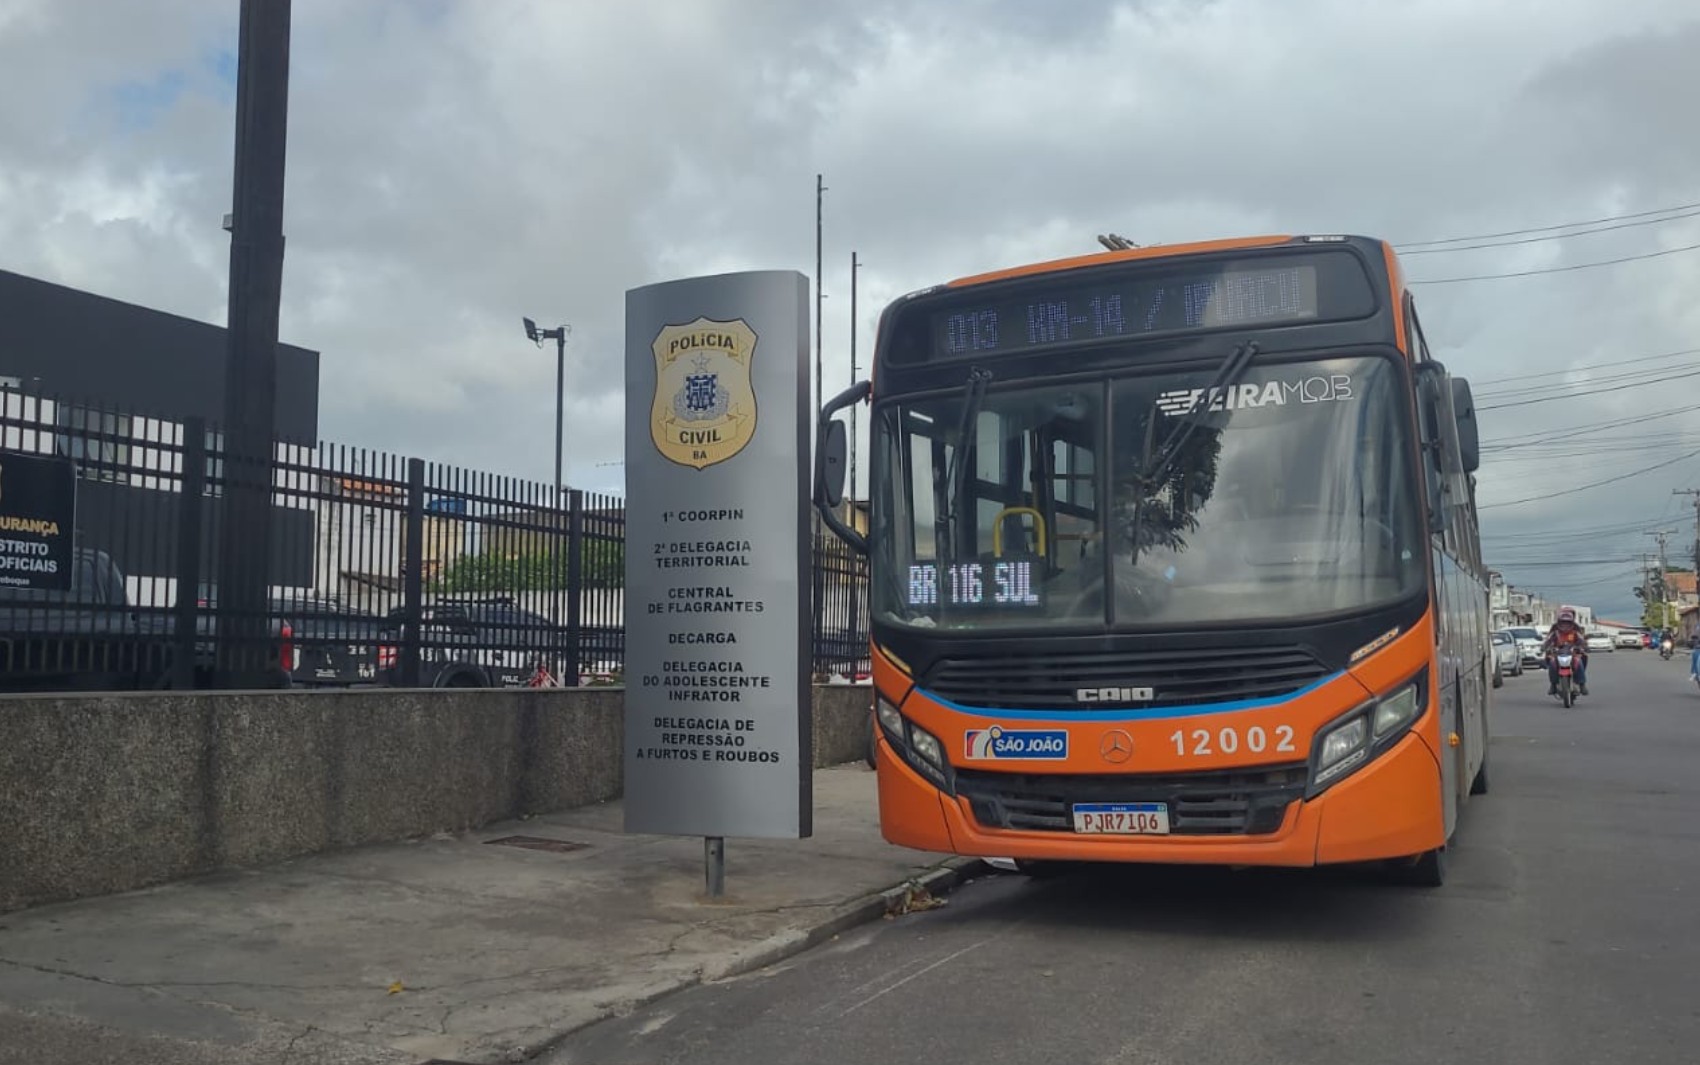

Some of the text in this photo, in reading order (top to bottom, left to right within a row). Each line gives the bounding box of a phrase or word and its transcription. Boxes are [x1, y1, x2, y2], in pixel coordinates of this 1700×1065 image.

[679, 429, 722, 445] CIVIL
[693, 450, 707, 460] BA
[678, 509, 744, 522] COORPIN
[670, 541, 752, 553] DELEGACIA
[656, 556, 751, 568] TERRITORIAL
[909, 561, 1039, 606] BR 116 SUL
[668, 587, 734, 599] CENTRAL
[648, 601, 764, 614] DE FLAGRANTES
[669, 633, 737, 644] DECARGA
[663, 661, 744, 673] DELEGACIA
[643, 675, 771, 688] DO ADOLESCENTE
[669, 691, 741, 702] INFRATOR
[1077, 687, 1153, 702] CAIO
[654, 717, 755, 731] DELEGACIA DE
[662, 732, 745, 747] REPRESSÃO
[995, 736, 1064, 752] SÃO JOÃO
[1170, 725, 1296, 757] 12002
[636, 748, 780, 763] A FURTOS E ROUBOS
